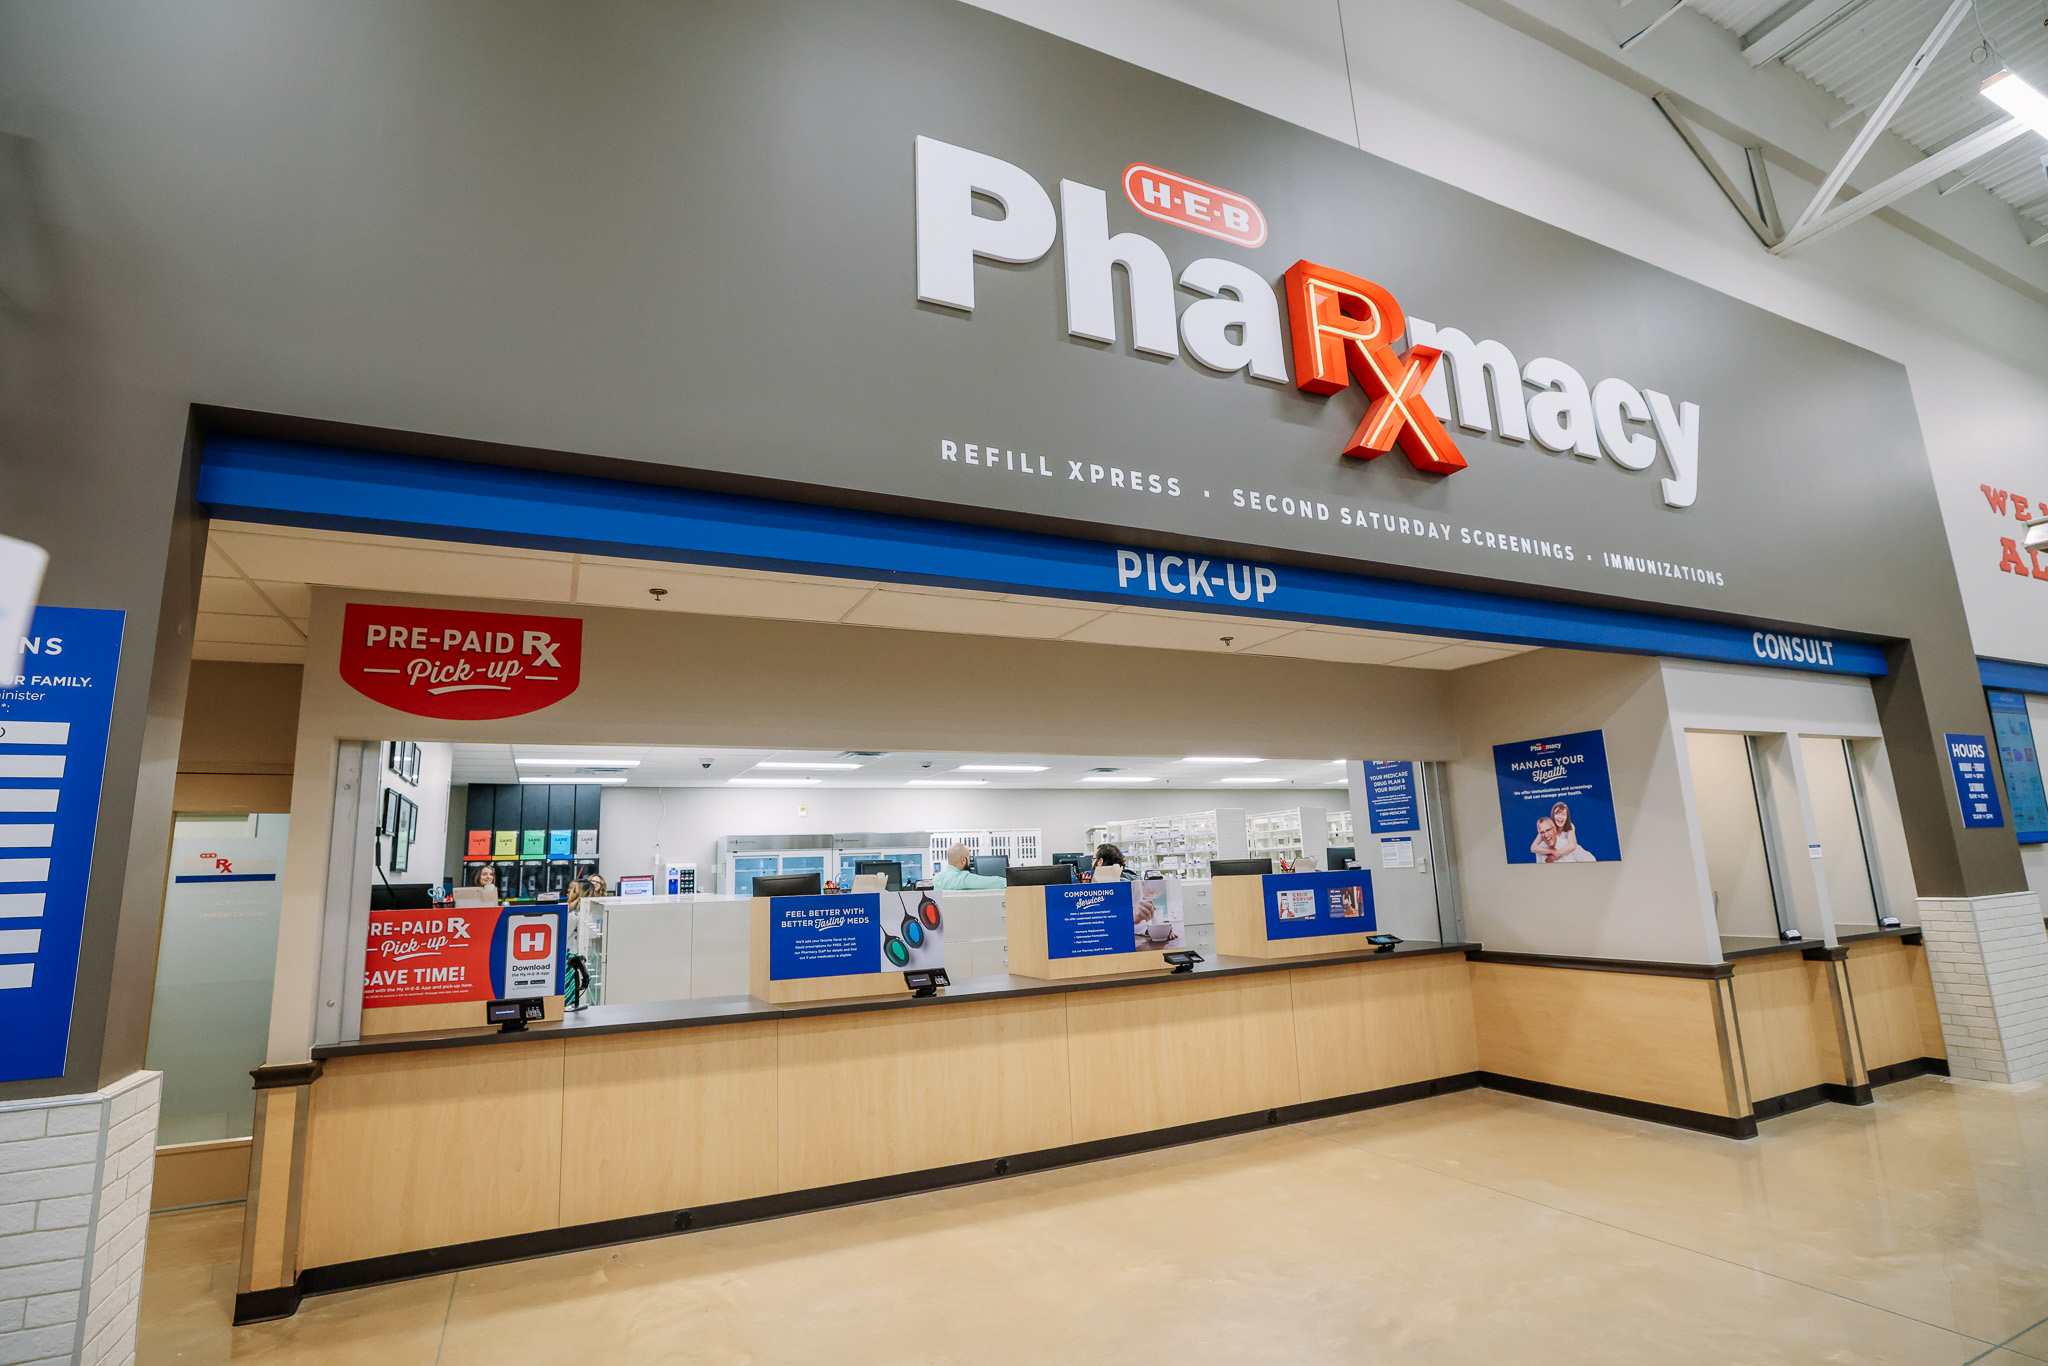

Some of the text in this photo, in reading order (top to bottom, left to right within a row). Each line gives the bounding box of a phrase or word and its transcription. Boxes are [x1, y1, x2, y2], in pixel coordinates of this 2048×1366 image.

[1980, 484, 2032, 521] WE
[941, 439, 1725, 586] REFILL XPRESS SECOND SATURDAY SCREENINGS IMMUNIZATIONS
[1117, 550, 1277, 603] PICK-UP
[366, 624, 562, 668] PRE-PAID Rx
[1752, 632, 1834, 665] CONSULT
[406, 658, 523, 686] Pick-up
[31, 676, 93, 688] FAMILY.
[0, 690, 46, 701] inister
[1951, 743, 1985, 758] HOURS
[1511, 754, 1584, 771] MANAGE YOUR
[1383, 771, 1408, 779] MEDICARE
[1532, 765, 1567, 782] Health
[216, 859, 233, 873] Rx
[1064, 889, 1114, 898] COMPOUNDING
[1076, 895, 1105, 909] Services
[786, 910, 807, 918] FEEL
[809, 909, 840, 917] BETTER
[368, 917, 471, 939] RE-PAID Rx
[781, 916, 869, 929] BETTER Tasting MEDS
[381, 935, 448, 958] Pick-up
[520, 932, 545, 952] H
[414, 966, 466, 983] TIME!
